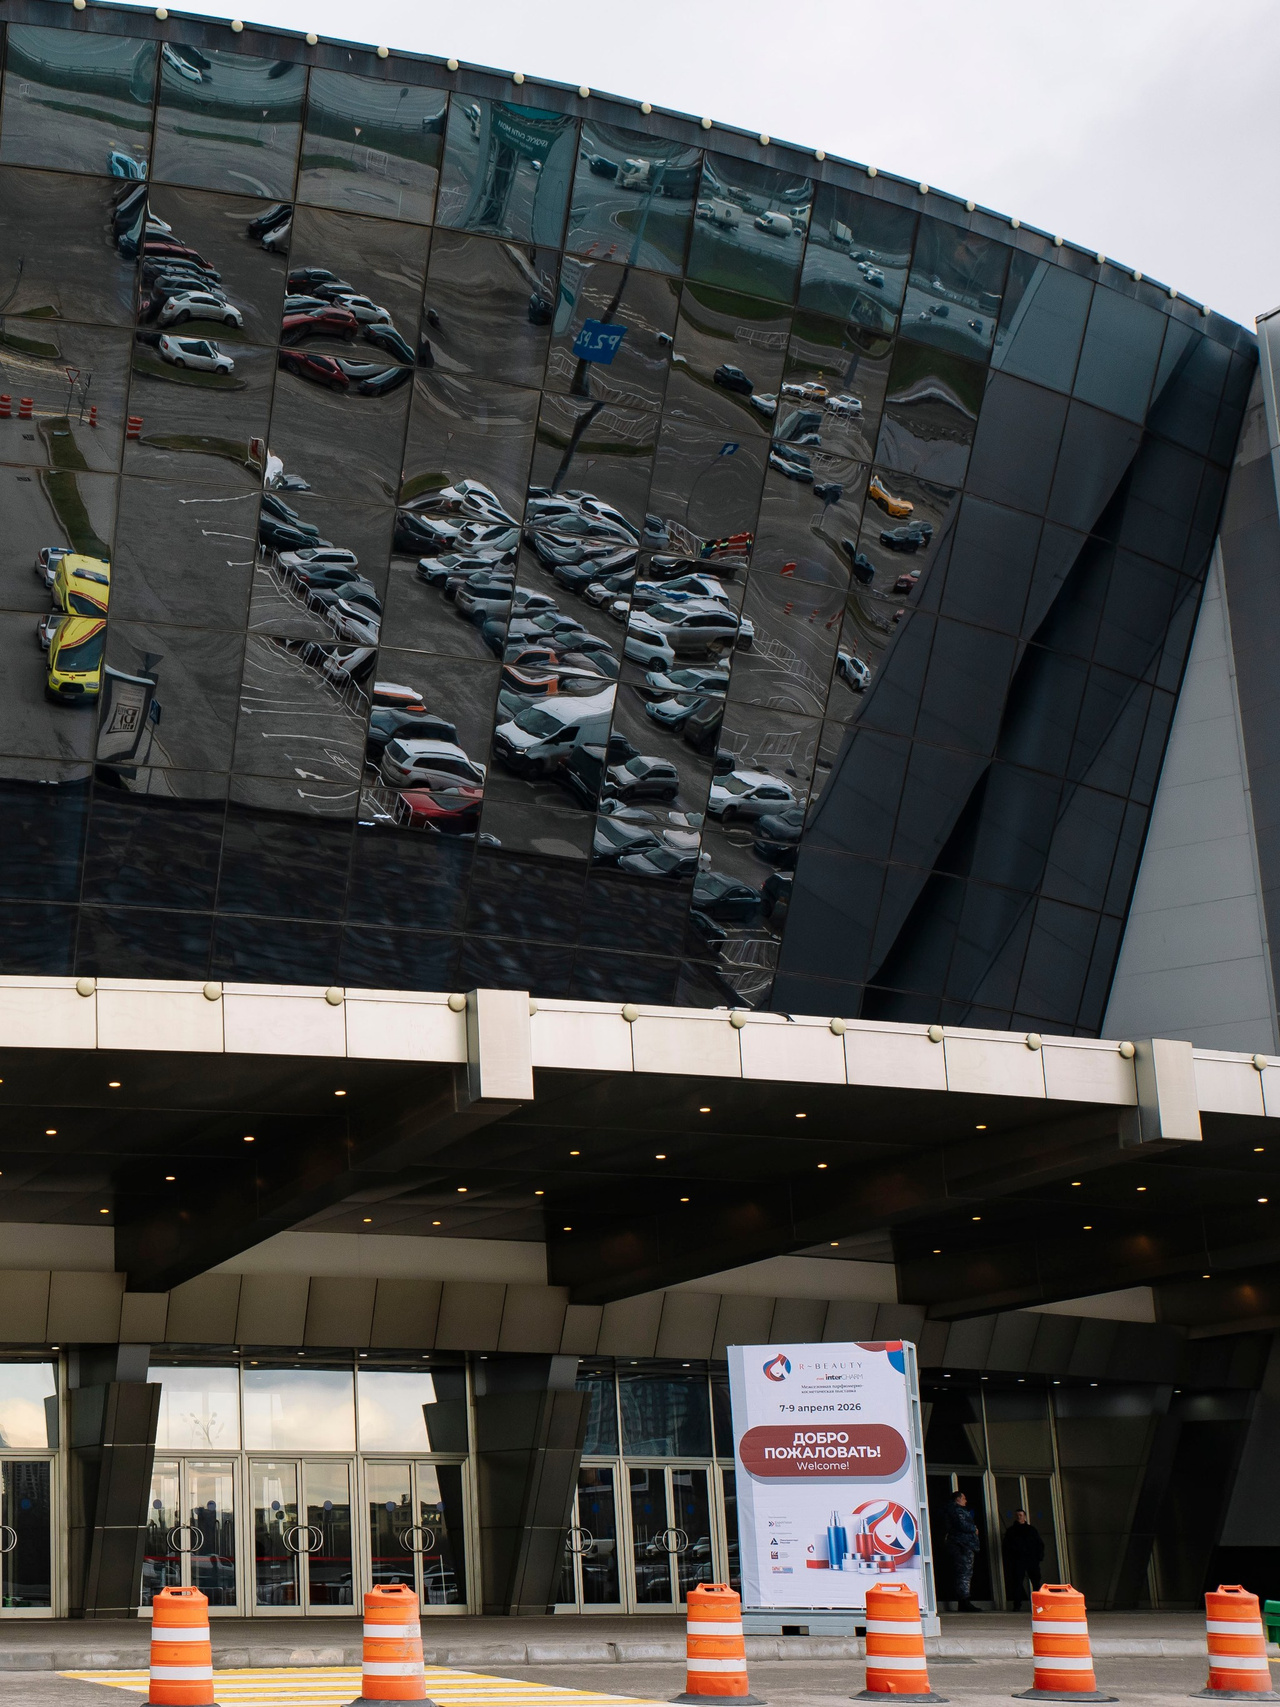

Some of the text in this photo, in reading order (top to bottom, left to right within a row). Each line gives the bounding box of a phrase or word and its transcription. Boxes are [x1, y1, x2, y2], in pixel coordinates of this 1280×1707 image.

[779, 1402, 862, 1413] 7-9 апреля 2026
[793, 1431, 849, 1446] ДОБРО
[764, 1446, 881, 1459] ПОЖАЛОВАТЬ!
[796, 1461, 850, 1470] Welcome!
